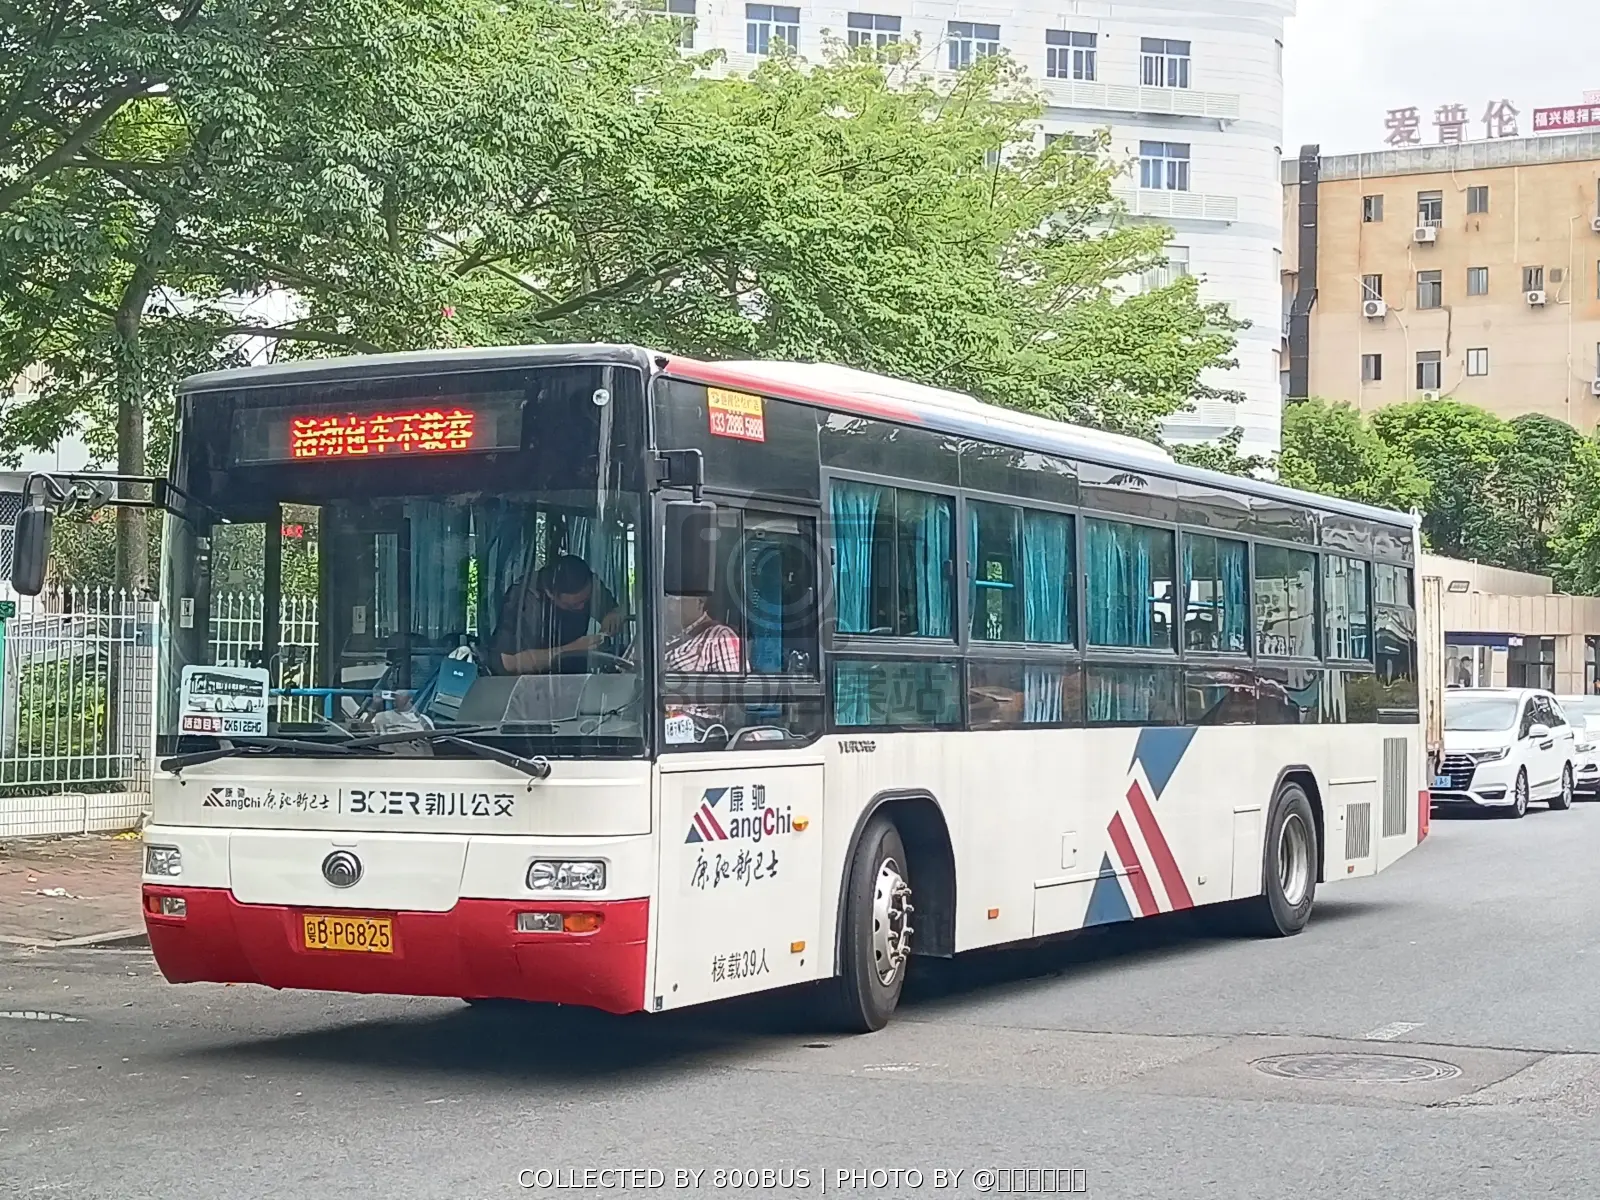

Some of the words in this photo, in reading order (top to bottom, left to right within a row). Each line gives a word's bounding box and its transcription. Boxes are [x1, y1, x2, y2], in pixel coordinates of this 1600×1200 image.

[1384, 99, 1521, 147] 爱普伦
[729, 784, 766, 812] 康驰
[711, 947, 770, 983] 核载39人
